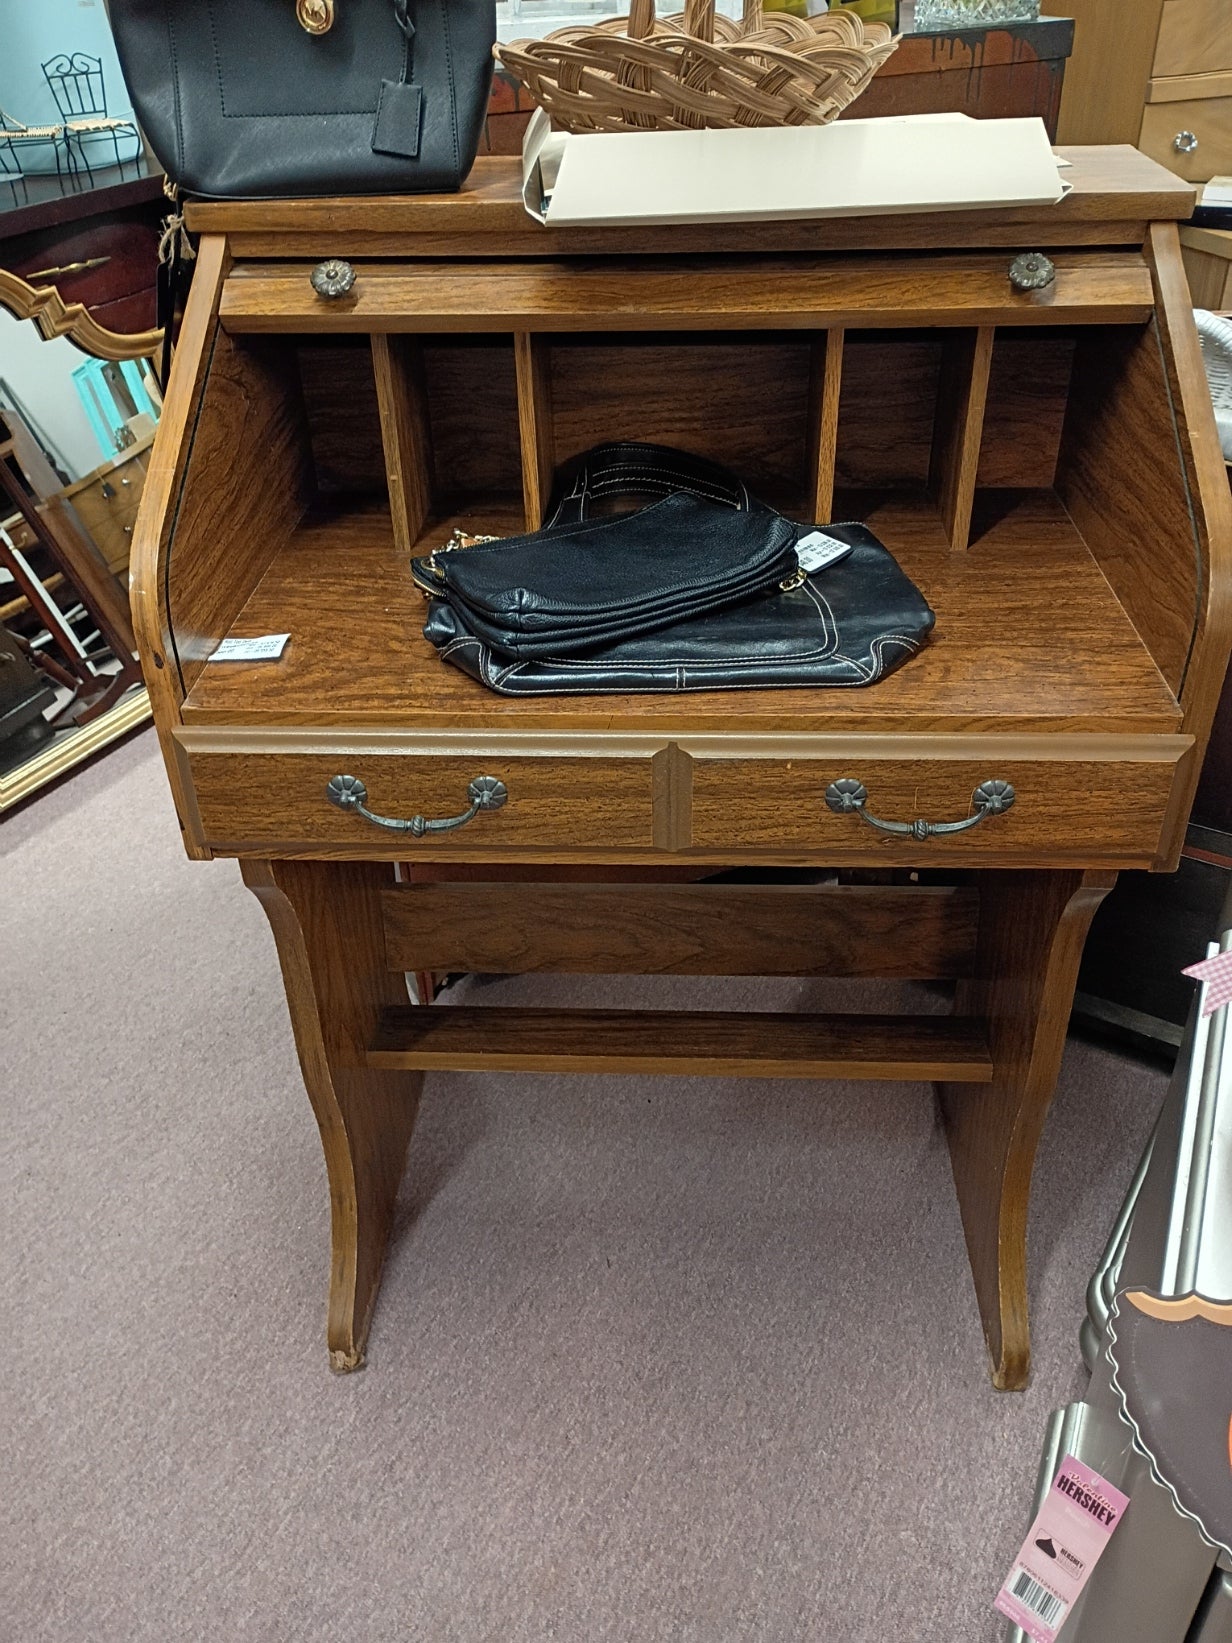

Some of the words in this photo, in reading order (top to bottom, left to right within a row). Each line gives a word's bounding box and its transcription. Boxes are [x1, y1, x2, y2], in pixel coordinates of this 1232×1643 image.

[1057, 1475, 1116, 1526] HERSHEY
[1069, 1472, 1117, 1512] Valentine
[1060, 1548, 1084, 1569] HERSHEY
